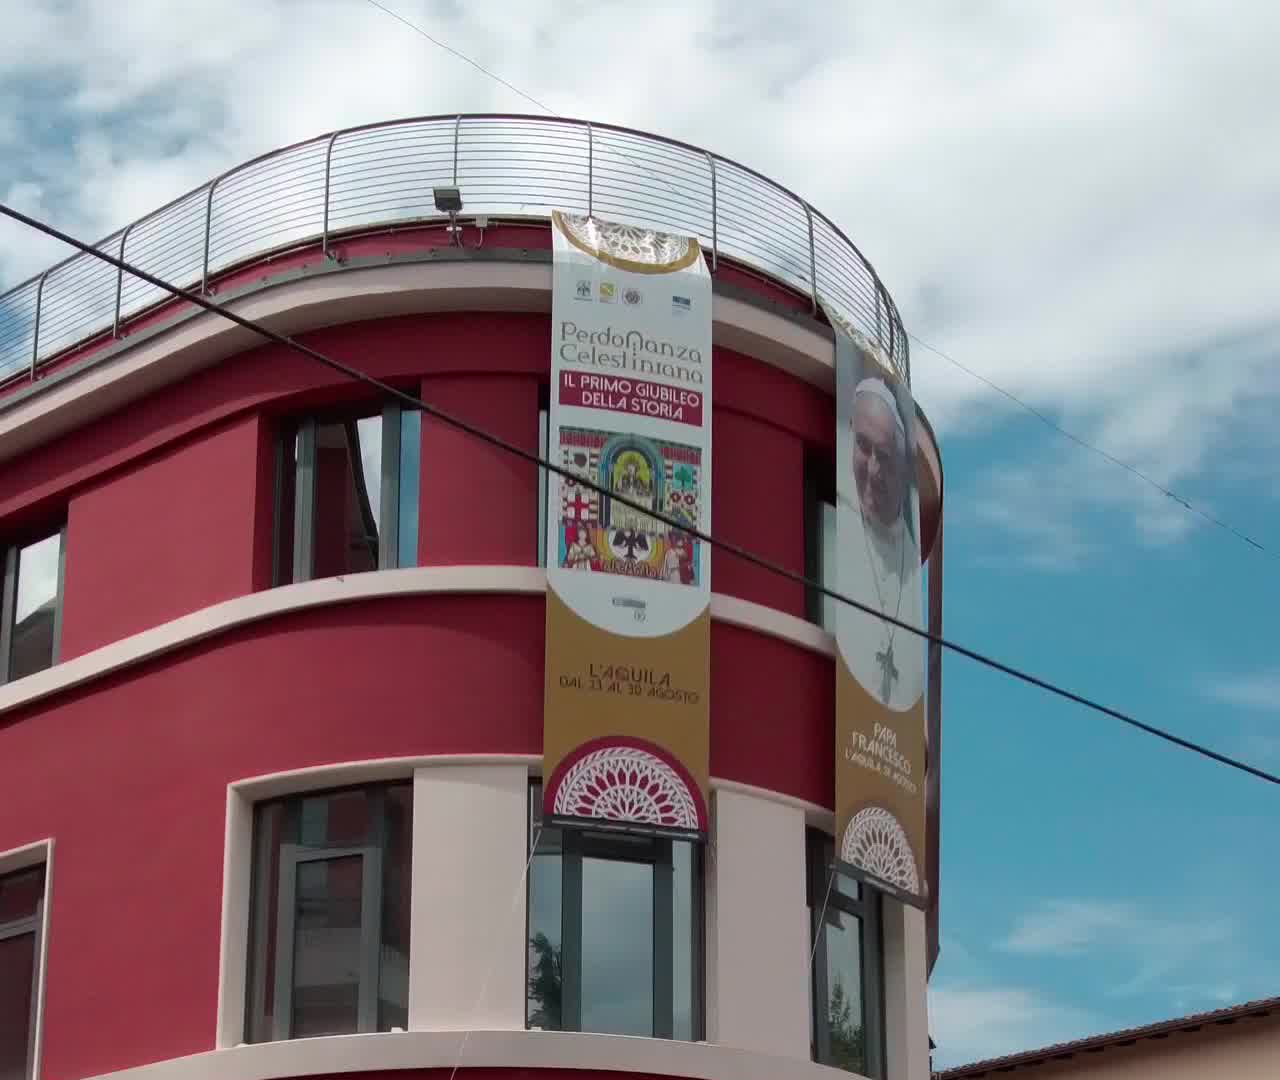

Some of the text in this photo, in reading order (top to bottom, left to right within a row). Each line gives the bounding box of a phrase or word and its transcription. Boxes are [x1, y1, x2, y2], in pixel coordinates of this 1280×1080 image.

[560, 344, 704, 384] Celestiniana
[564, 374, 699, 408] IL PRIMO GIUBILEO
[581, 391, 683, 420] DELLA STORIA
[559, 674, 583, 689] DAL
[606, 682, 623, 695] AL
[646, 686, 700, 705] AGOSTO
[589, 663, 671, 687] L'AQUILA
[873, 721, 897, 750] PAPA
[851, 731, 912, 776] FRANCESCO
